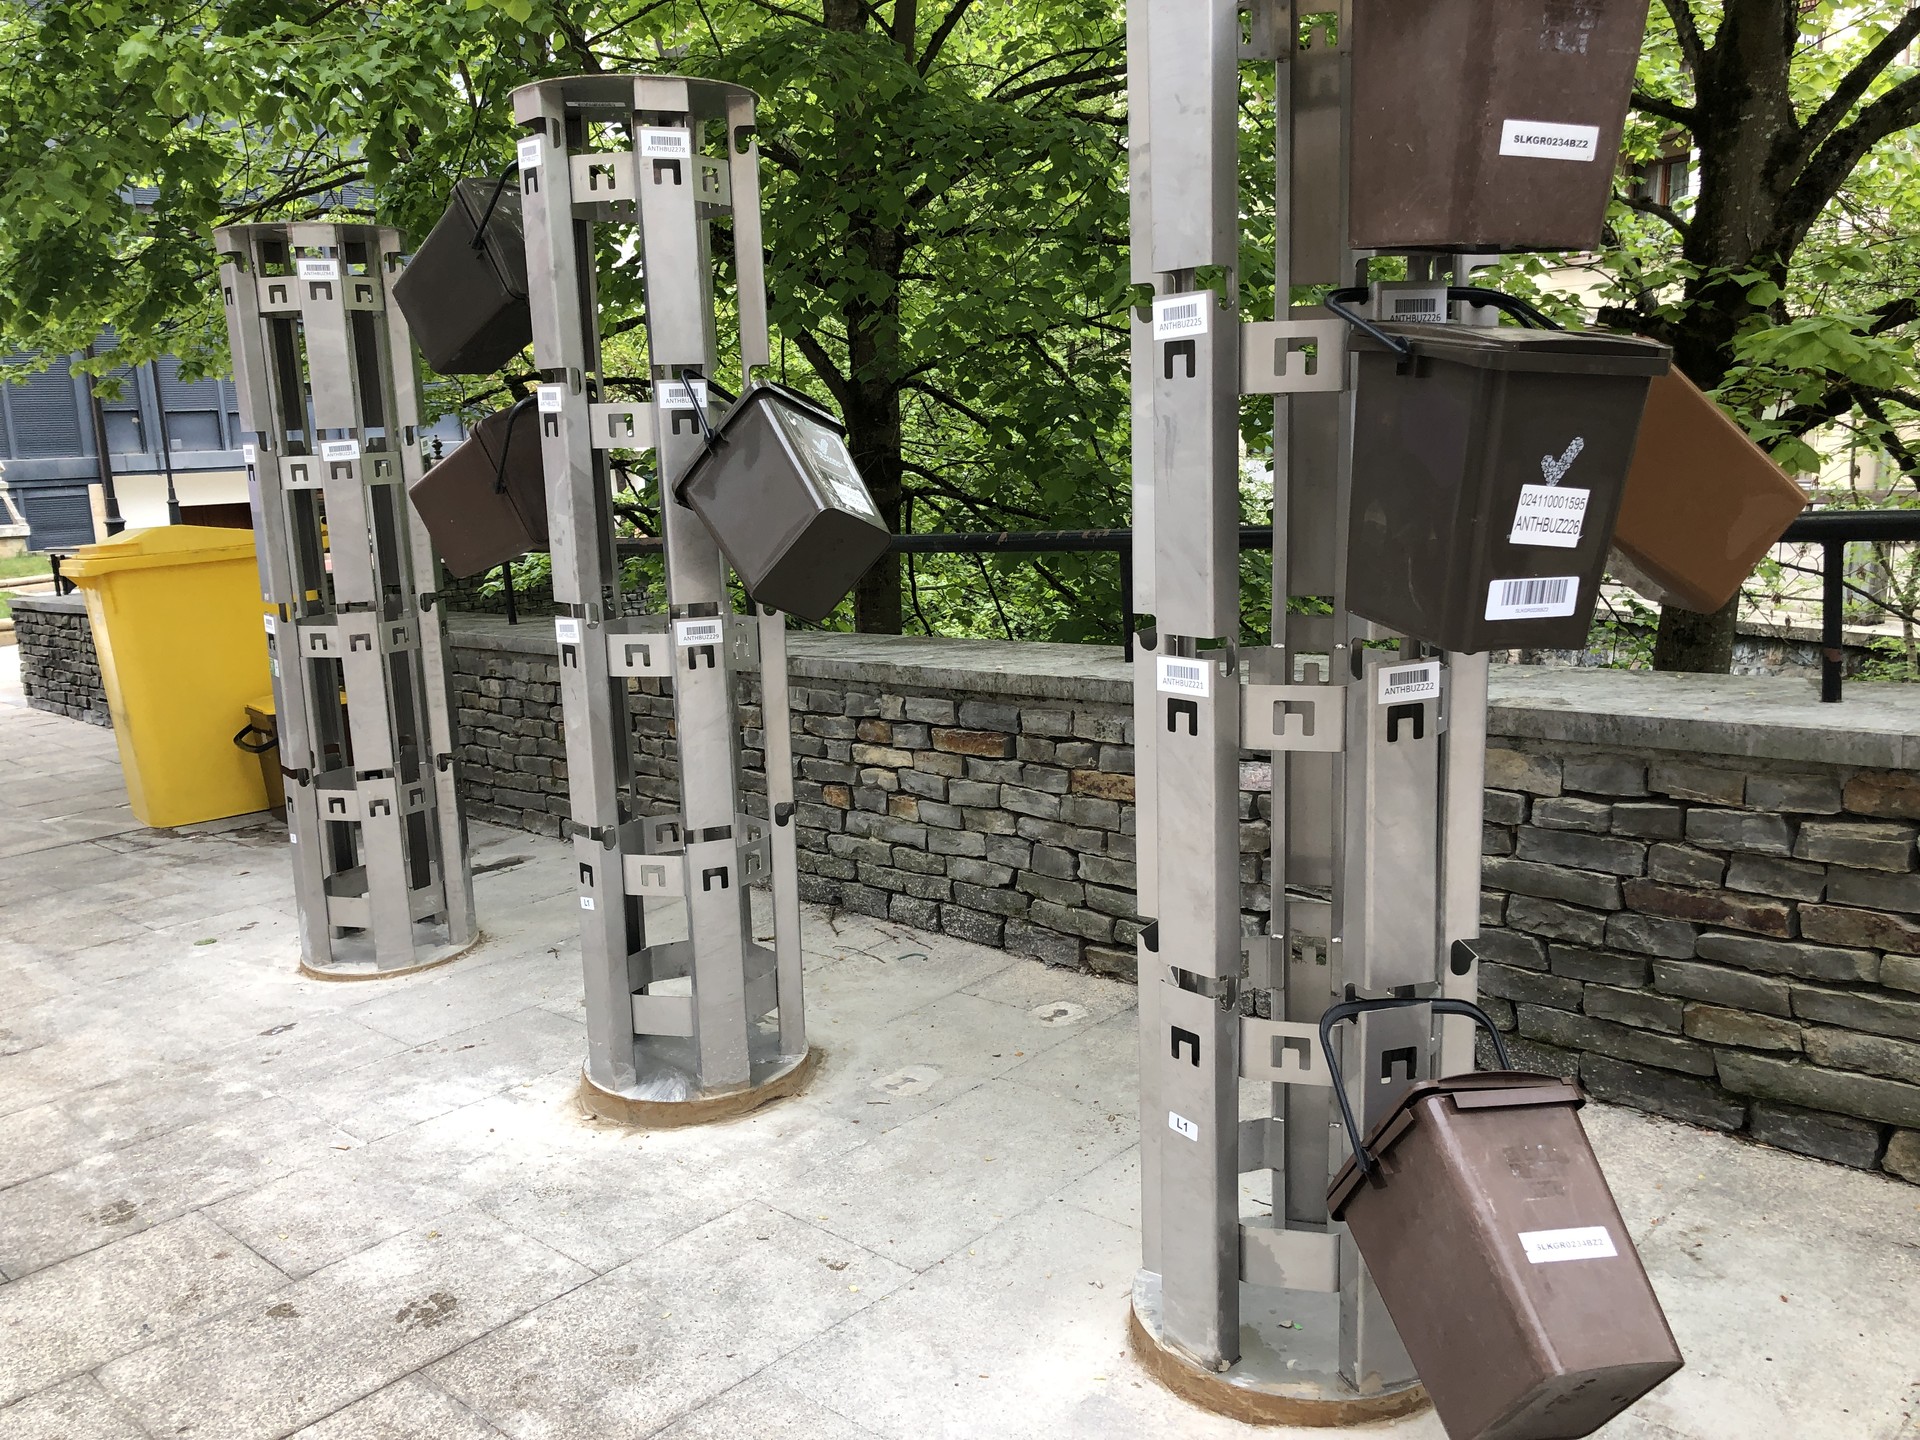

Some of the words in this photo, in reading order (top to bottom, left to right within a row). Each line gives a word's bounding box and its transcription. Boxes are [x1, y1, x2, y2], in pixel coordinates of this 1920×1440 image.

[1514, 134, 1588, 149] SLKGR0234BZ2
[647, 145, 686, 153] ANTHBUZ278
[1159, 317, 1202, 331] ANTHBUZ225
[1390, 313, 1441, 322] ANTHBUZ226
[1520, 493, 1586, 510] 024110001595
[1514, 516, 1580, 535] ANTHBUZ226
[683, 633, 719, 641] ANTHBUZ229
[1162, 677, 1204, 690] ANTHBUZ221
[1384, 682, 1434, 695] ANTHBUZ222
[1176, 1117, 1188, 1132] L1
